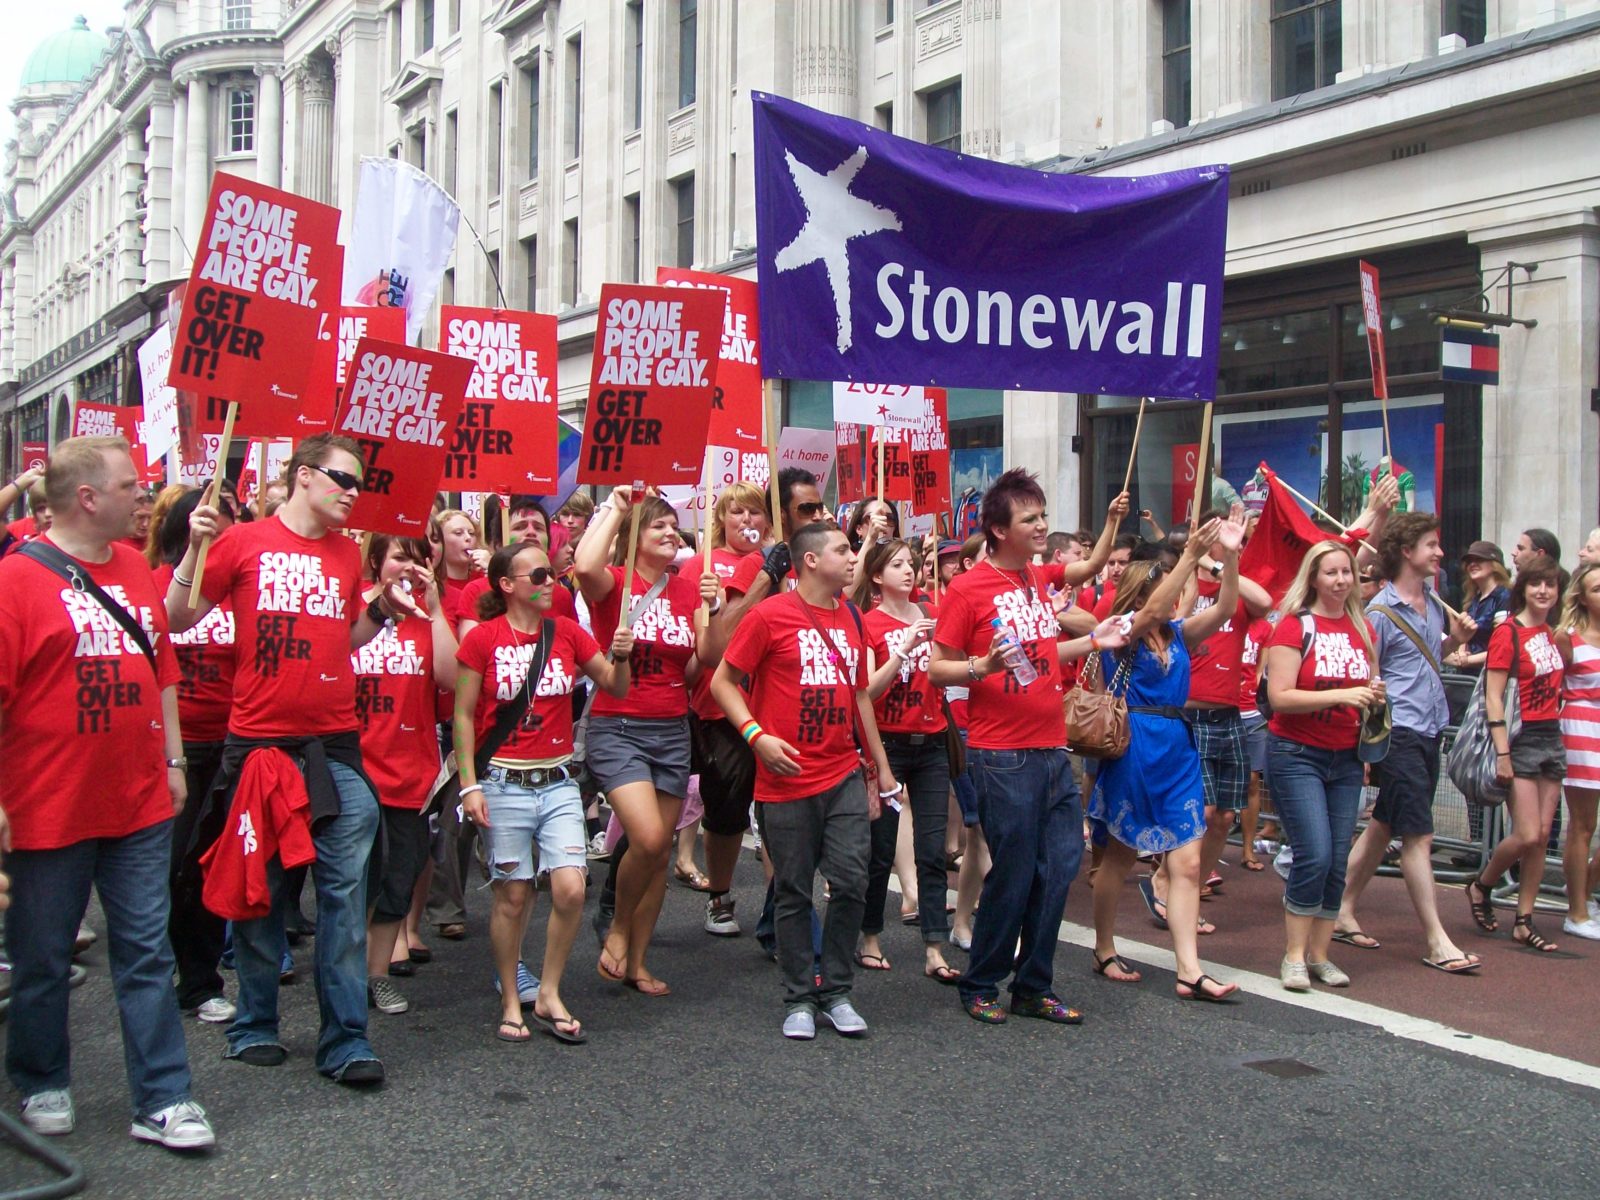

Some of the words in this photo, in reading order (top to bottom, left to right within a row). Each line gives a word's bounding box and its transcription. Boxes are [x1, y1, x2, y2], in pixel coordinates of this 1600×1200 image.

[215, 190, 298, 240] SOME
[208, 219, 311, 275] PEOPLE
[199, 251, 262, 293] ARE
[263, 267, 318, 309] GAY.
[194, 286, 252, 325] GET
[606, 298, 683, 330] SOME
[875, 262, 1207, 358] Stonewall
[188, 316, 265, 360] OVER
[448, 319, 521, 350] SOME
[603, 328, 700, 359] PEOPLE
[180, 346, 220, 380] IT!
[356, 352, 432, 390] SOME
[598, 356, 653, 386] ARE
[656, 358, 709, 387] GAY.
[350, 378, 443, 419] PEOPLE
[465, 374, 497, 399] RE
[501, 376, 552, 403] GAY.
[79, 408, 116, 425] SOME
[597, 389, 648, 418] GET
[341, 405, 396, 438] ARE
[396, 414, 447, 447] GAY.
[592, 417, 662, 445] OVER
[887, 414, 922, 425] Stonewall
[450, 428, 513, 455] OVER
[911, 434, 930, 451] ARE
[588, 445, 624, 473] IT!
[742, 453, 769, 468] SOM
[782, 449, 795, 460] At
[798, 449, 829, 462] home
[742, 467, 770, 482] PEOP
[259, 552, 322, 575] SOME
[258, 570, 340, 598] PEOPLE
[256, 589, 300, 613] ARE
[305, 594, 346, 620] GAY.
[256, 614, 299, 637] GET
[633, 625, 657, 642] RE
[74, 632, 121, 657] ARE
[255, 637, 312, 661] OVER
[359, 640, 416, 657] EOPLE
[495, 643, 537, 664] SOM
[1314, 643, 1365, 664] PEOPLE
[76, 660, 121, 684] GET
[387, 656, 425, 676] GAY.
[800, 665, 838, 685] ARE
[1314, 660, 1346, 678] ARE
[77, 682, 142, 709] OVER
[800, 688, 836, 707] GET
[77, 709, 111, 734] IT!
[797, 724, 824, 743] IT!
